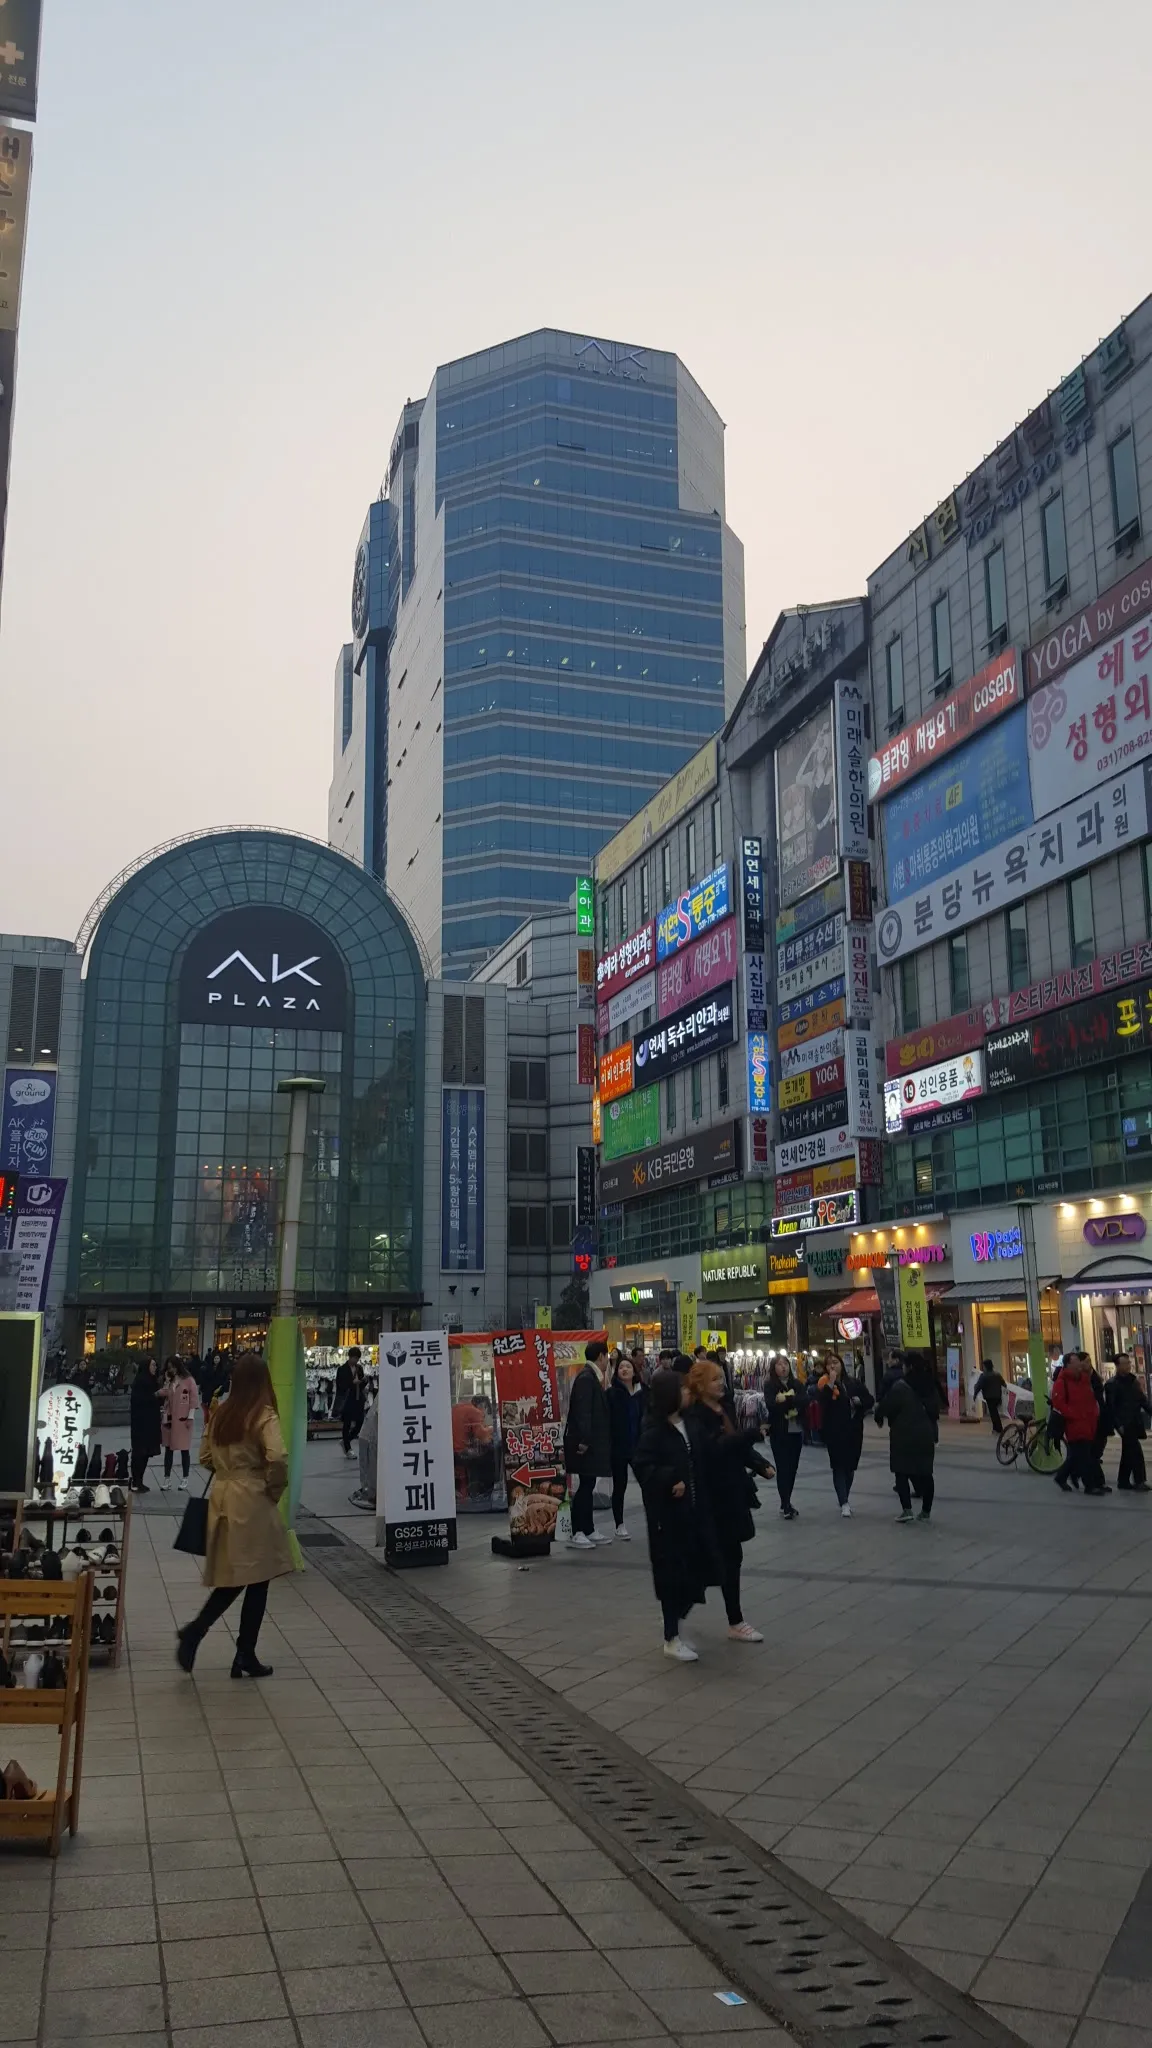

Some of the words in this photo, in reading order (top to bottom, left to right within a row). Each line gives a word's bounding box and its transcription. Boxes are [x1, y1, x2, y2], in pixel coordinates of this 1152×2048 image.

[578, 361, 647, 383] PLAZA
[1032, 616, 1092, 680] YOGA
[1097, 603, 1116, 632] by
[1121, 578, 1152, 615] cos
[883, 737, 909, 782] 플라잉
[973, 663, 1016, 712] cosery
[847, 709, 865, 836] 미래솔한의원
[948, 785, 960, 806] 4F
[578, 878, 592, 929] 소아과
[746, 859, 761, 923] 연세안과
[677, 890, 691, 947] S
[815, 922, 833, 946] 수선
[206, 950, 323, 987] AK
[661, 958, 683, 1004] 플라잉
[750, 956, 765, 1005] 사진관
[852, 936, 869, 1003] 미용재료
[208, 992, 320, 1011] PLAZA
[781, 990, 827, 1021] 금거래소
[1013, 963, 1096, 1018] 스티커사진
[649, 1031, 667, 1060] 연세
[802, 1038, 838, 1063] 미래솔한의원
[601, 1055, 631, 1088] 이비인후과
[816, 1064, 838, 1085] YOGA
[904, 1082, 915, 1100] 19
[919, 1068, 958, 1098] 성인용품
[15, 1088, 46, 1097] ground
[26, 1141, 46, 1157] FUN
[450, 1127, 460, 1171] 가입즉시
[647, 1144, 695, 1183] KB국민은행
[781, 1137, 826, 1167] 연세안경원
[27, 1163, 40, 1174] 쇼
[449, 1174, 462, 1184] 5%
[468, 1127, 478, 1205] AK멤버스카드
[450, 1186, 460, 1230] 할인혜택
[777, 1219, 798, 1236] Arena
[817, 1199, 837, 1226] PC
[1092, 1219, 1136, 1240] VDL
[575, 1254, 592, 1271] 방
[899, 1245, 944, 1265] DONUTS
[703, 1268, 726, 1283] NATURE
[727, 1264, 758, 1280] REPUBLIC
[410, 1340, 443, 1366] 콩툰
[494, 1334, 526, 1355] 원조
[400, 1374, 435, 1512] 만화카페
[505, 1428, 554, 1460] 화통삼
[394, 1527, 424, 1539] GS25
[427, 1523, 449, 1537] 건물
